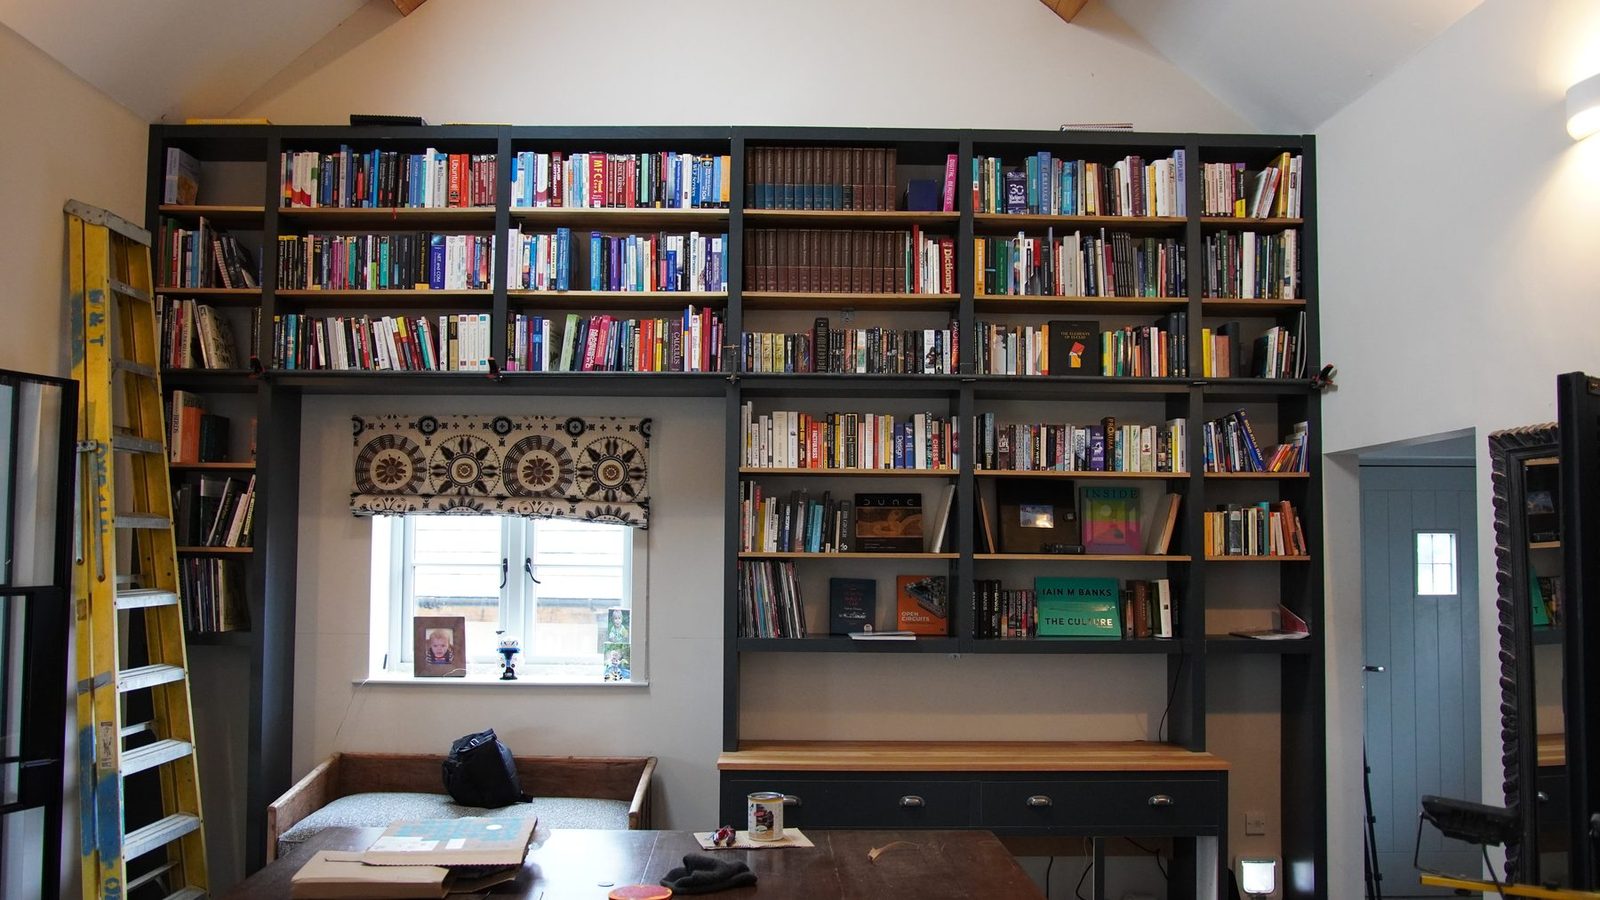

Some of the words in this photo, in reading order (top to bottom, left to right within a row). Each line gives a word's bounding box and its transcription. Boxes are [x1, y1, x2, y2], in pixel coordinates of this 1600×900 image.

[451, 160, 459, 184] Ubuntu
[593, 160, 603, 178] MFC
[943, 249, 954, 294] Dictionary
[896, 436, 904, 459] Design
[1085, 488, 1138, 498] INSIDE
[1042, 588, 1063, 596] IAIN
[1067, 588, 1075, 596] M
[1078, 588, 1112, 597] BANKS
[1067, 617, 1113, 626] CULTURE
